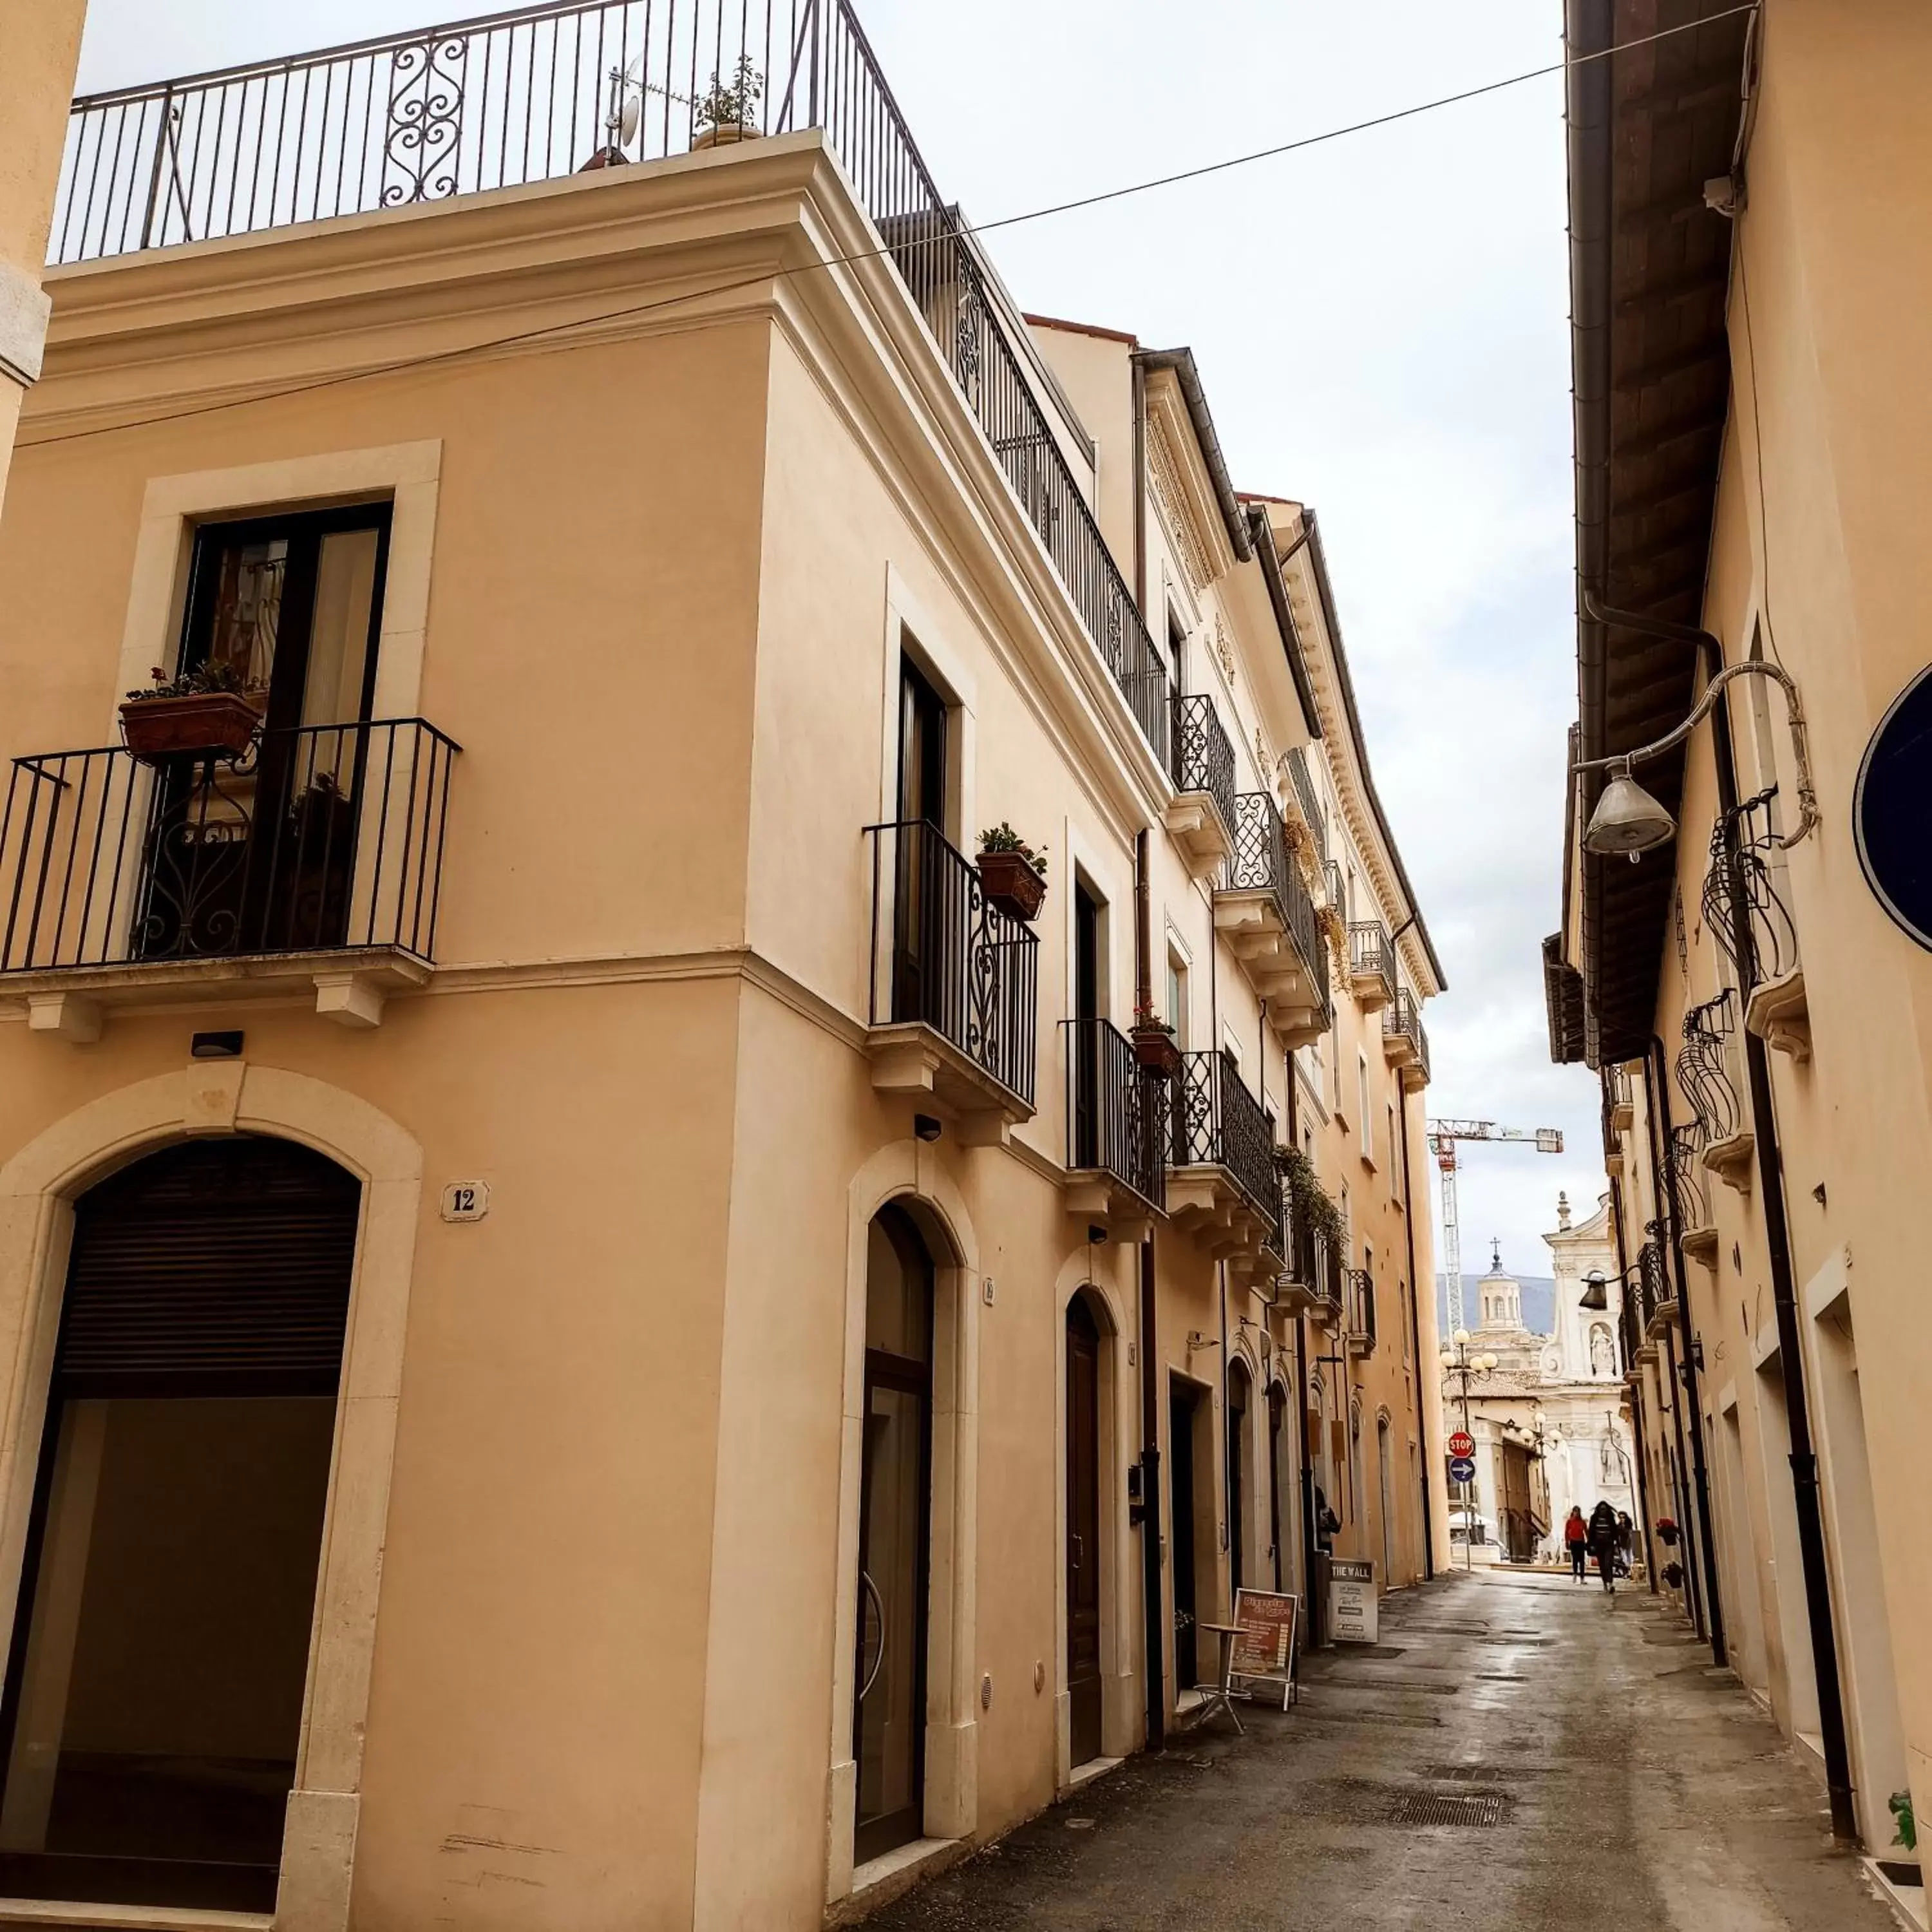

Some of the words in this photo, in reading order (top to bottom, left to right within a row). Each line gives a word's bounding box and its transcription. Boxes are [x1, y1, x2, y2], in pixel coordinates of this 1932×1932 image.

[453, 1188, 475, 1211] 12
[1450, 1439, 1472, 1450] STOP
[1332, 1566, 1347, 1577] THE
[1348, 1566, 1369, 1578] WALL
